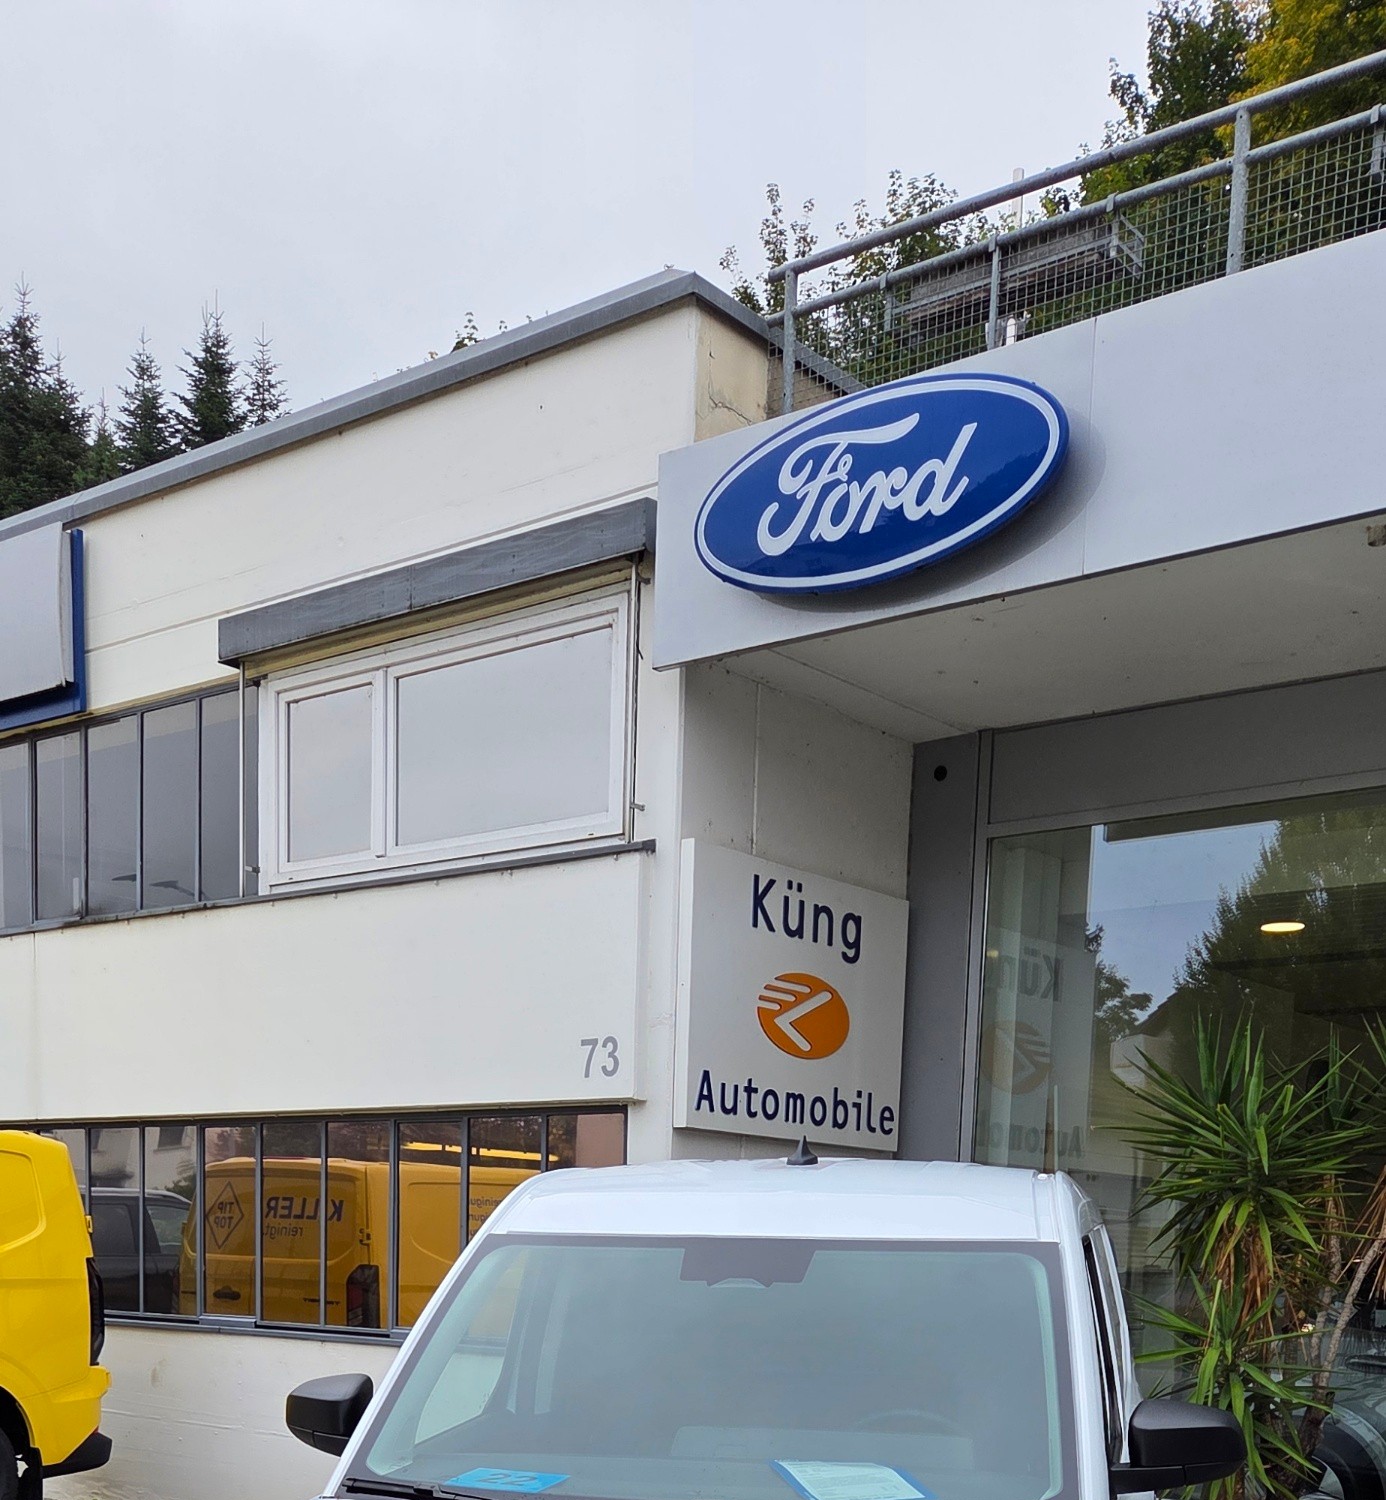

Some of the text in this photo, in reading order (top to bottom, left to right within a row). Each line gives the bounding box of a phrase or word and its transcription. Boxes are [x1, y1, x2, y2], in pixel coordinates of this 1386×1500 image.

[756, 412, 978, 556] Ford
[751, 873, 863, 965] Küng
[580, 1035, 620, 1079] 73
[694, 1069, 896, 1137] Automobile
